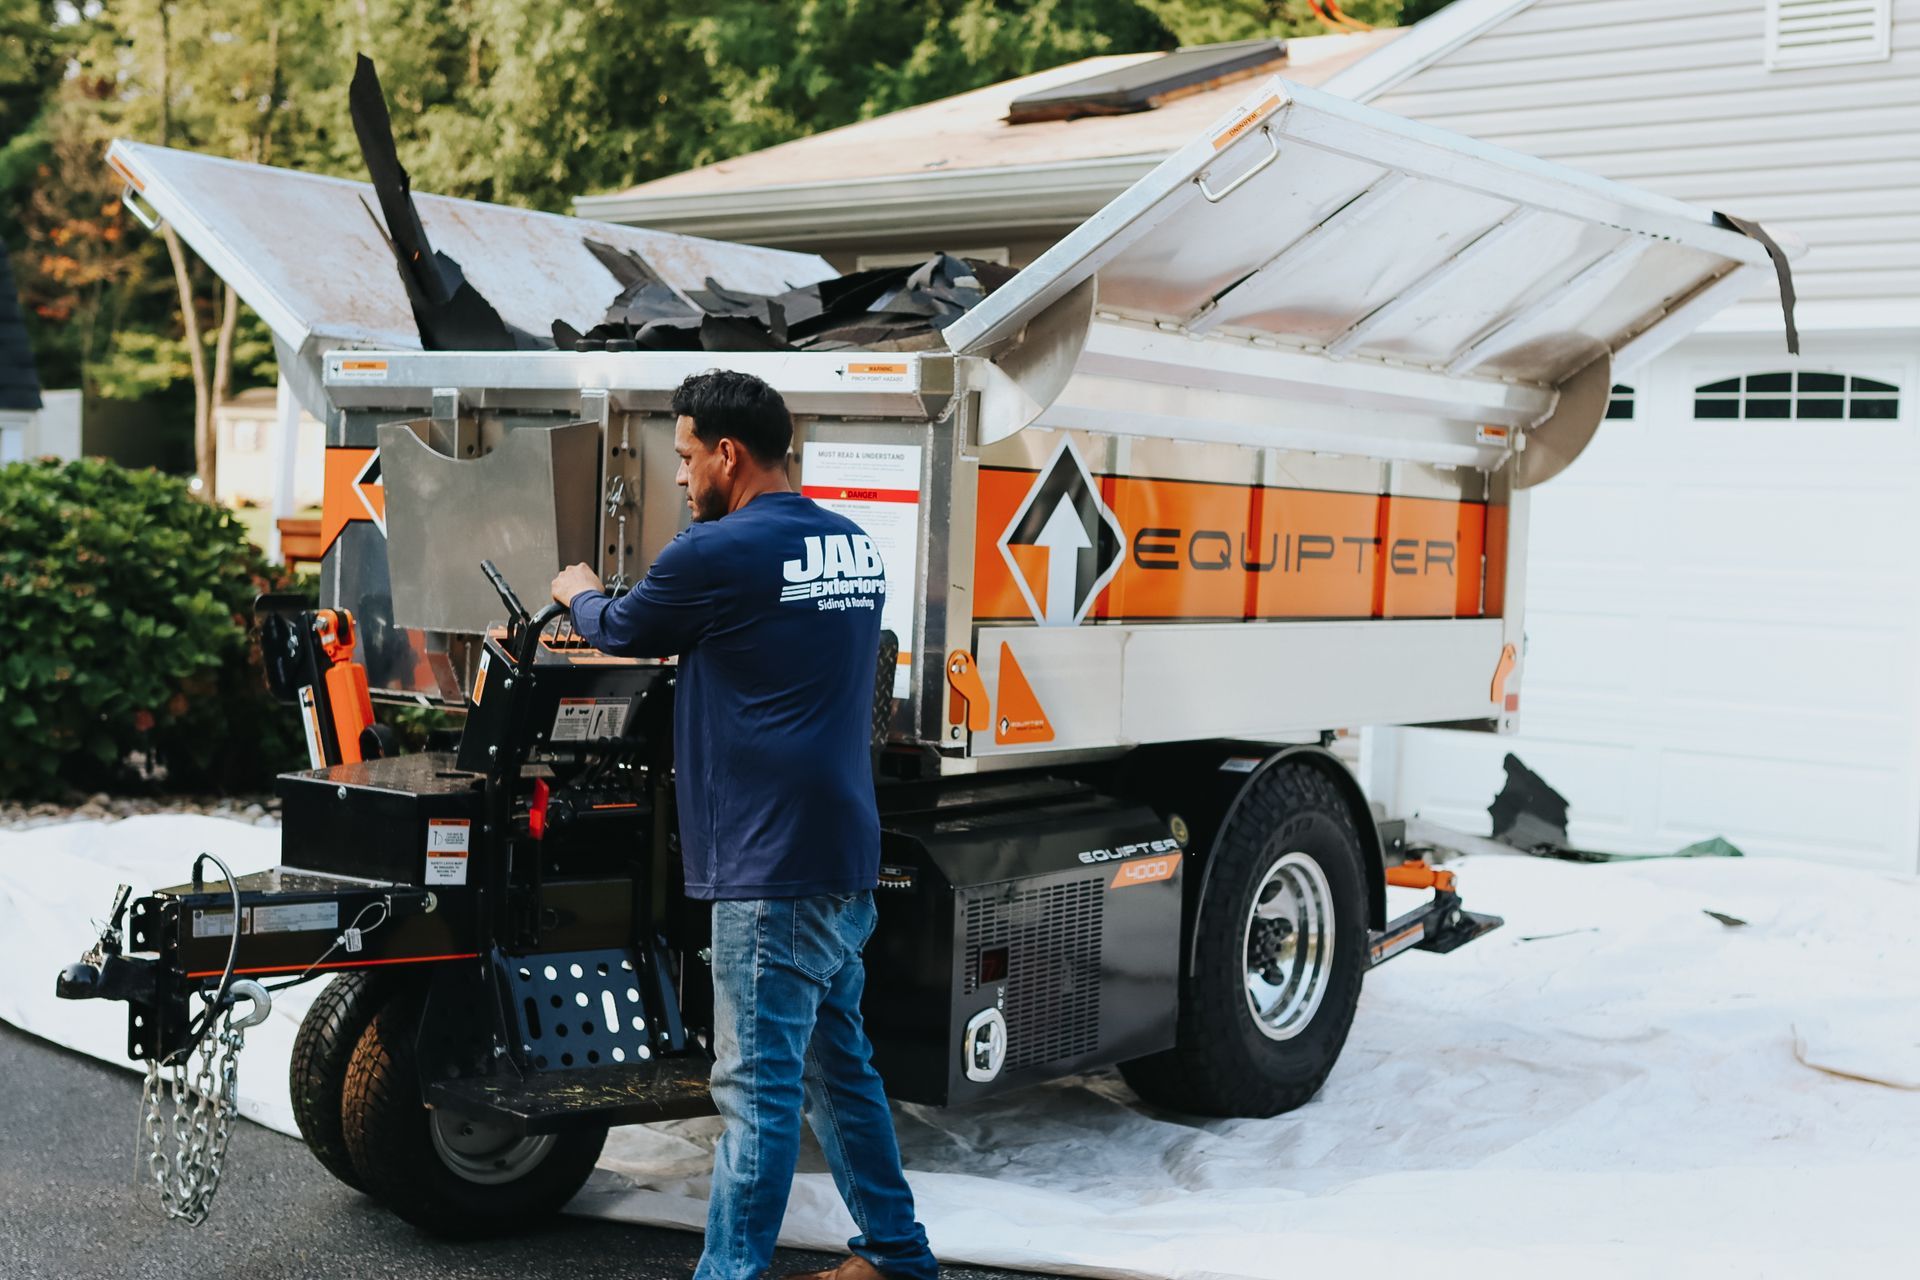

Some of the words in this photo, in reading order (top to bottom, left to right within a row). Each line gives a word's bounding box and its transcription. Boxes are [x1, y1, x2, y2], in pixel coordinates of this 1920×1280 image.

[861, 452, 905, 460] UNDERSTAND
[847, 490, 878, 499] DANGER
[783, 534, 883, 583] JAB
[1133, 527, 1456, 576] EQUIPTER
[810, 578, 886, 598] Exteriors
[817, 598, 846, 611] Siding
[845, 597, 852, 608] &
[852, 596, 875, 610] Roofing
[1078, 838, 1179, 864] EQUIPTER
[1125, 861, 1168, 880] 4000
